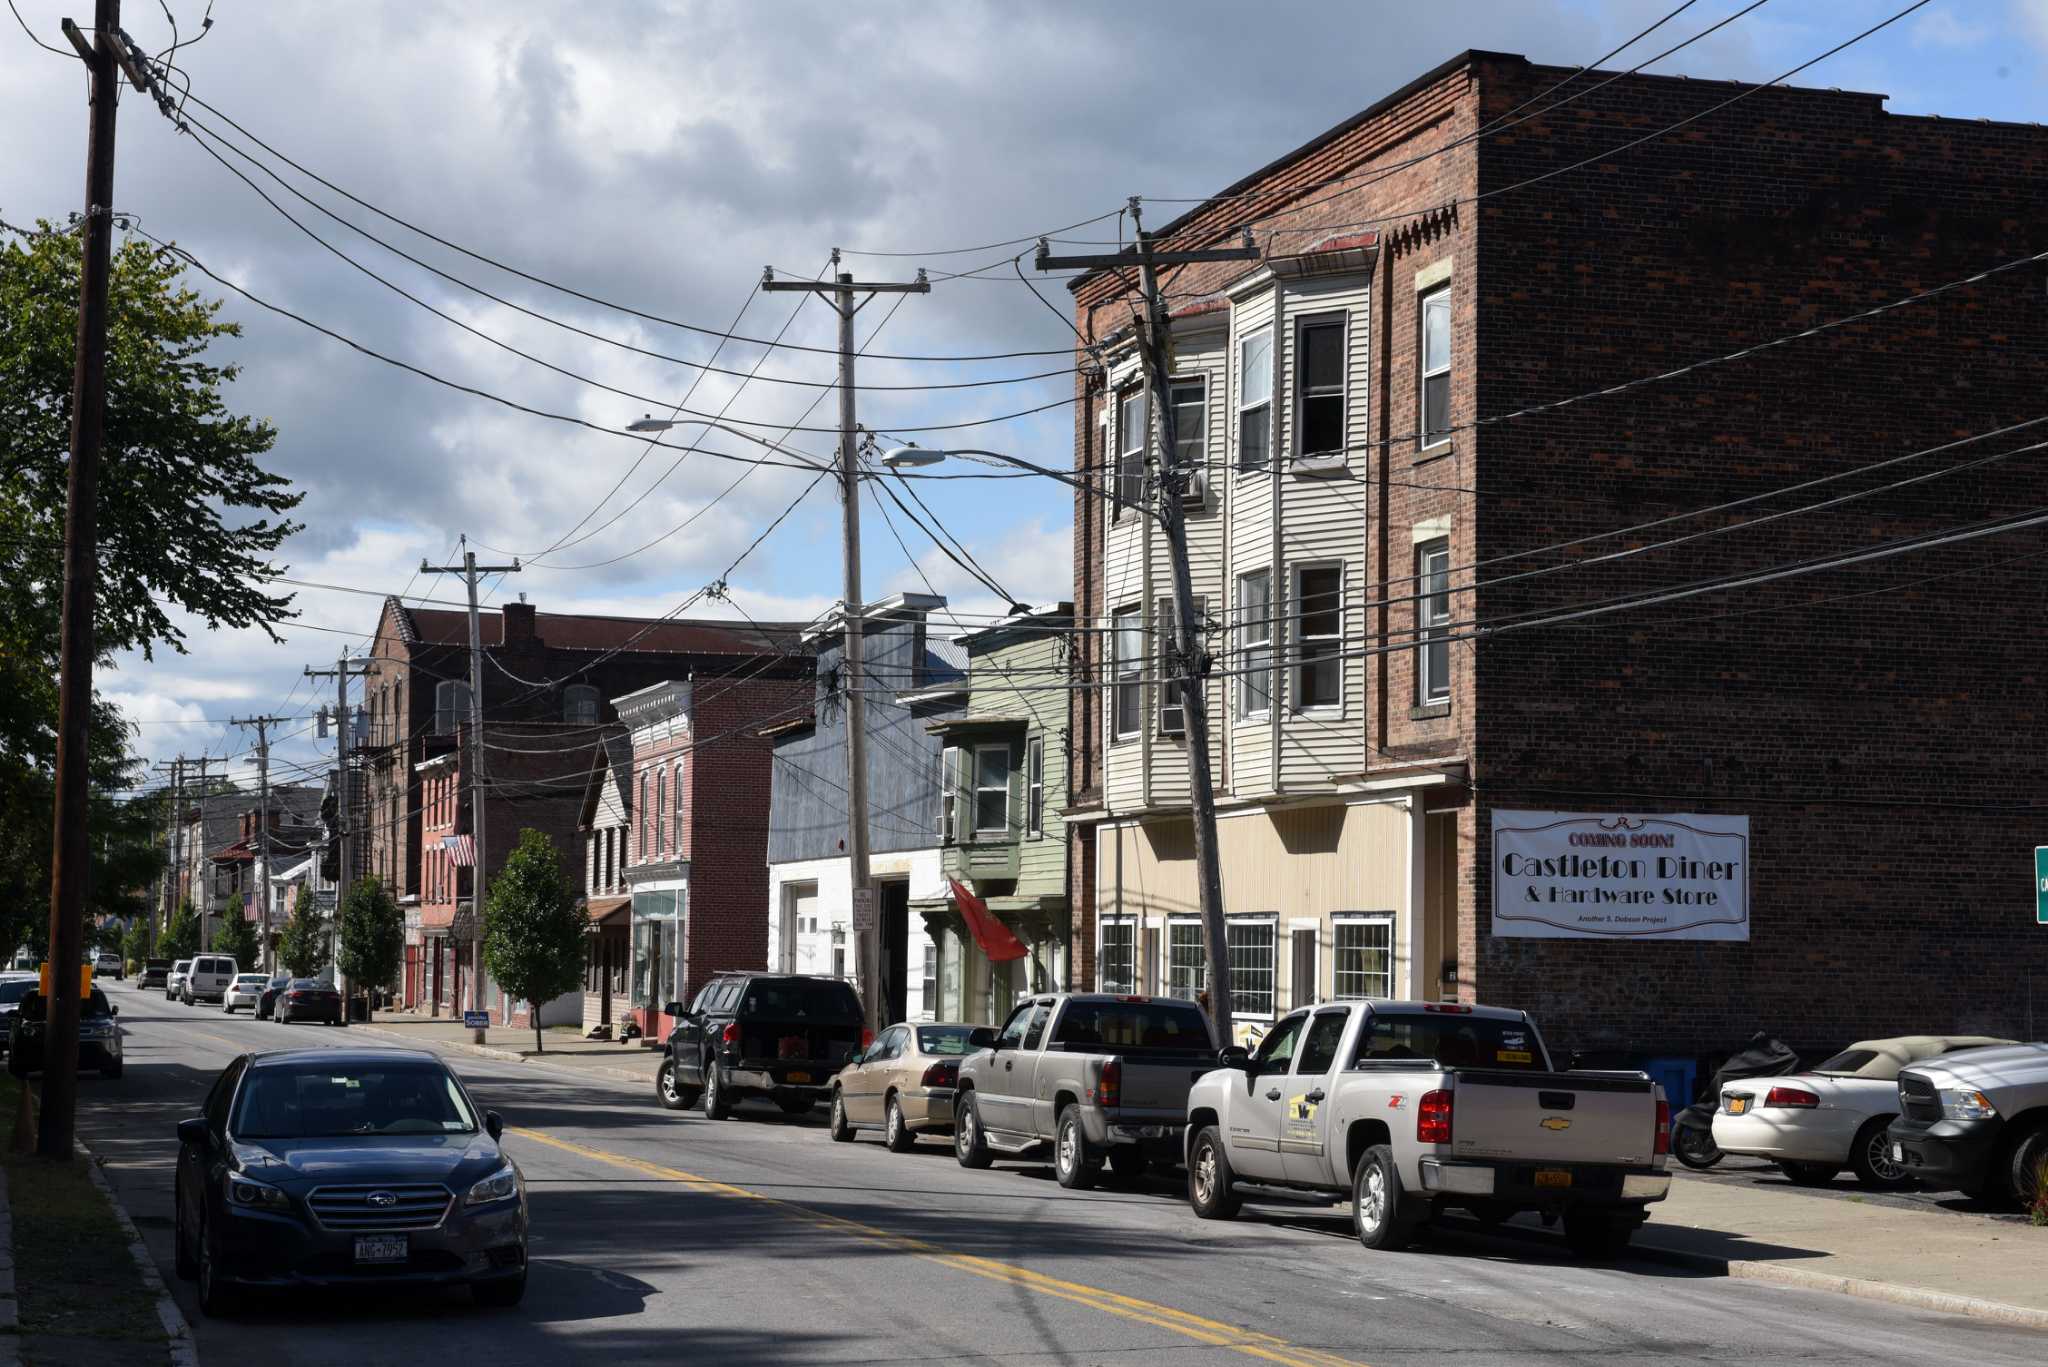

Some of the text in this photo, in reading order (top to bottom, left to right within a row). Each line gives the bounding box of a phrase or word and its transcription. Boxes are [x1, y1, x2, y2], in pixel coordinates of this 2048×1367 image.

[1568, 832, 1675, 849] COMING SOON!
[1502, 852, 1740, 881] Castleton Diner
[1524, 885, 1718, 906] & Hardware Store
[1577, 914, 1605, 923] Another
[1642, 915, 1668, 926] Project
